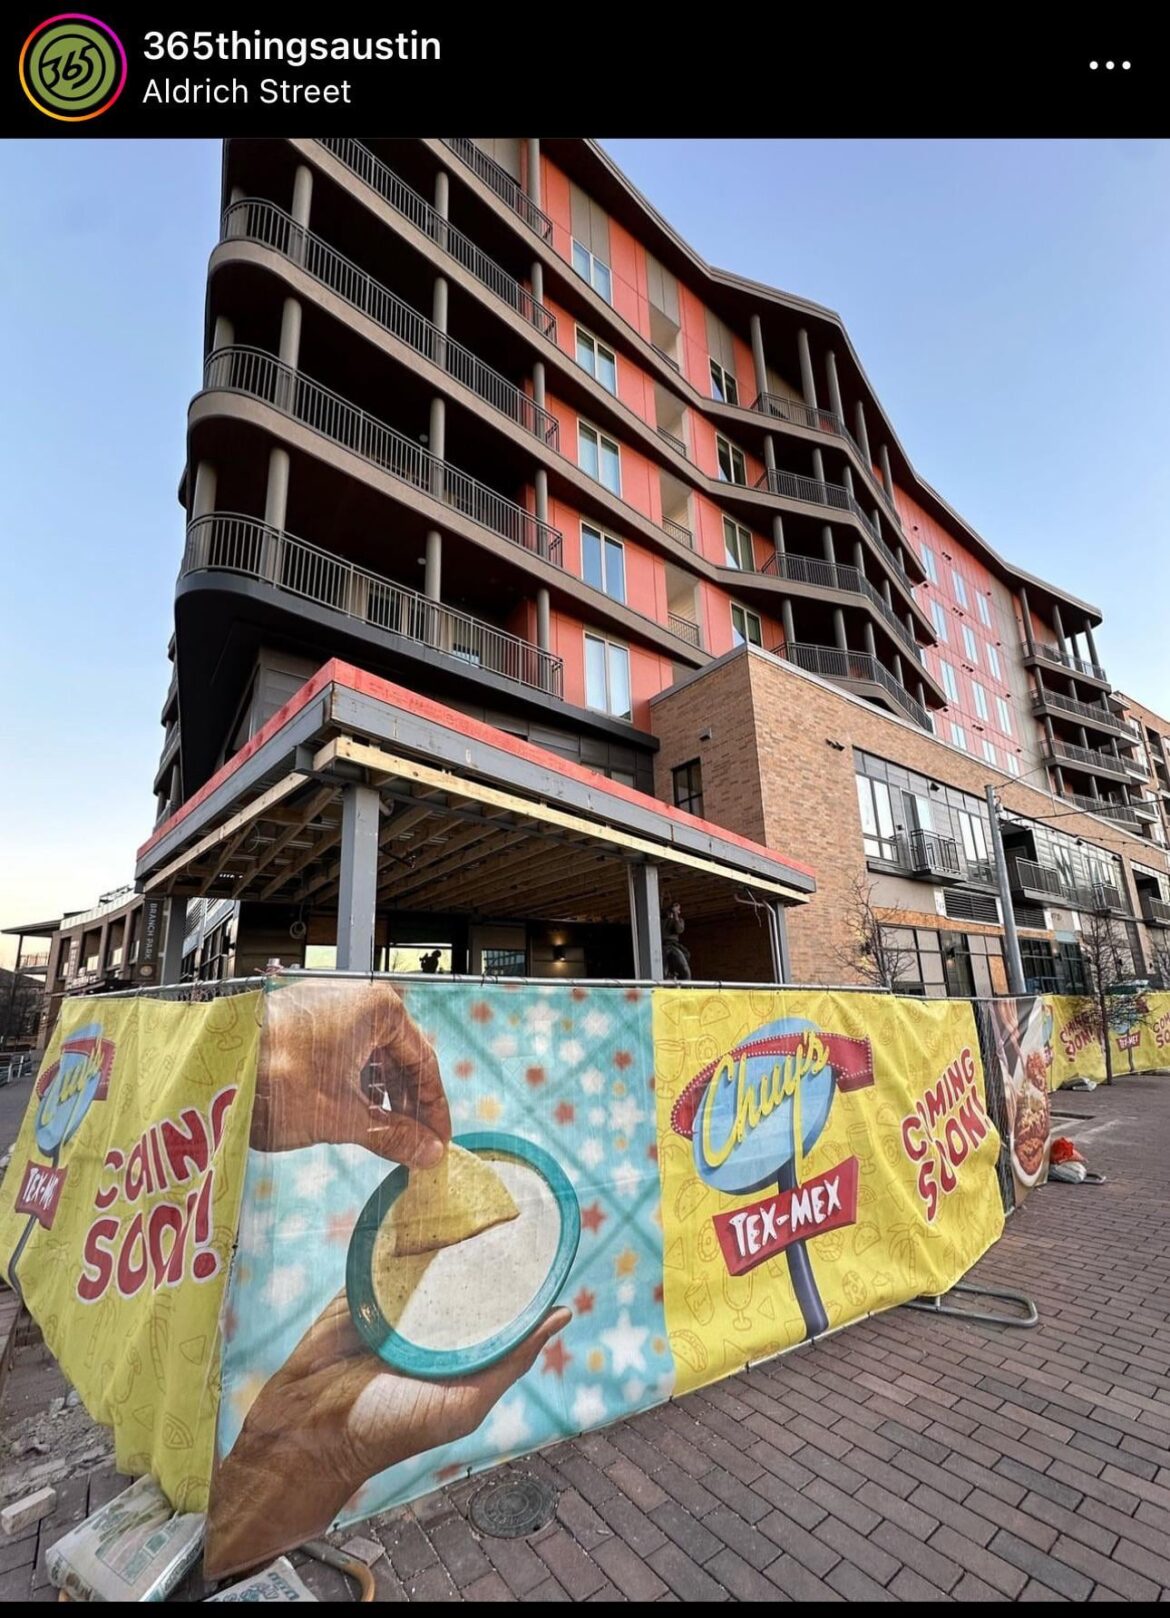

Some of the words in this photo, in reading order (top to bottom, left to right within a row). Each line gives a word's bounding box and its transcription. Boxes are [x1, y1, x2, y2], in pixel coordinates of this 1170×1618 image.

[147, 903, 158, 936] BRANCH
[94, 1085, 238, 1210] COIN
[702, 1030, 830, 1189] Chuy's
[22, 1167, 59, 1211] TEX-M
[728, 1175, 842, 1257] TEX-MEX
